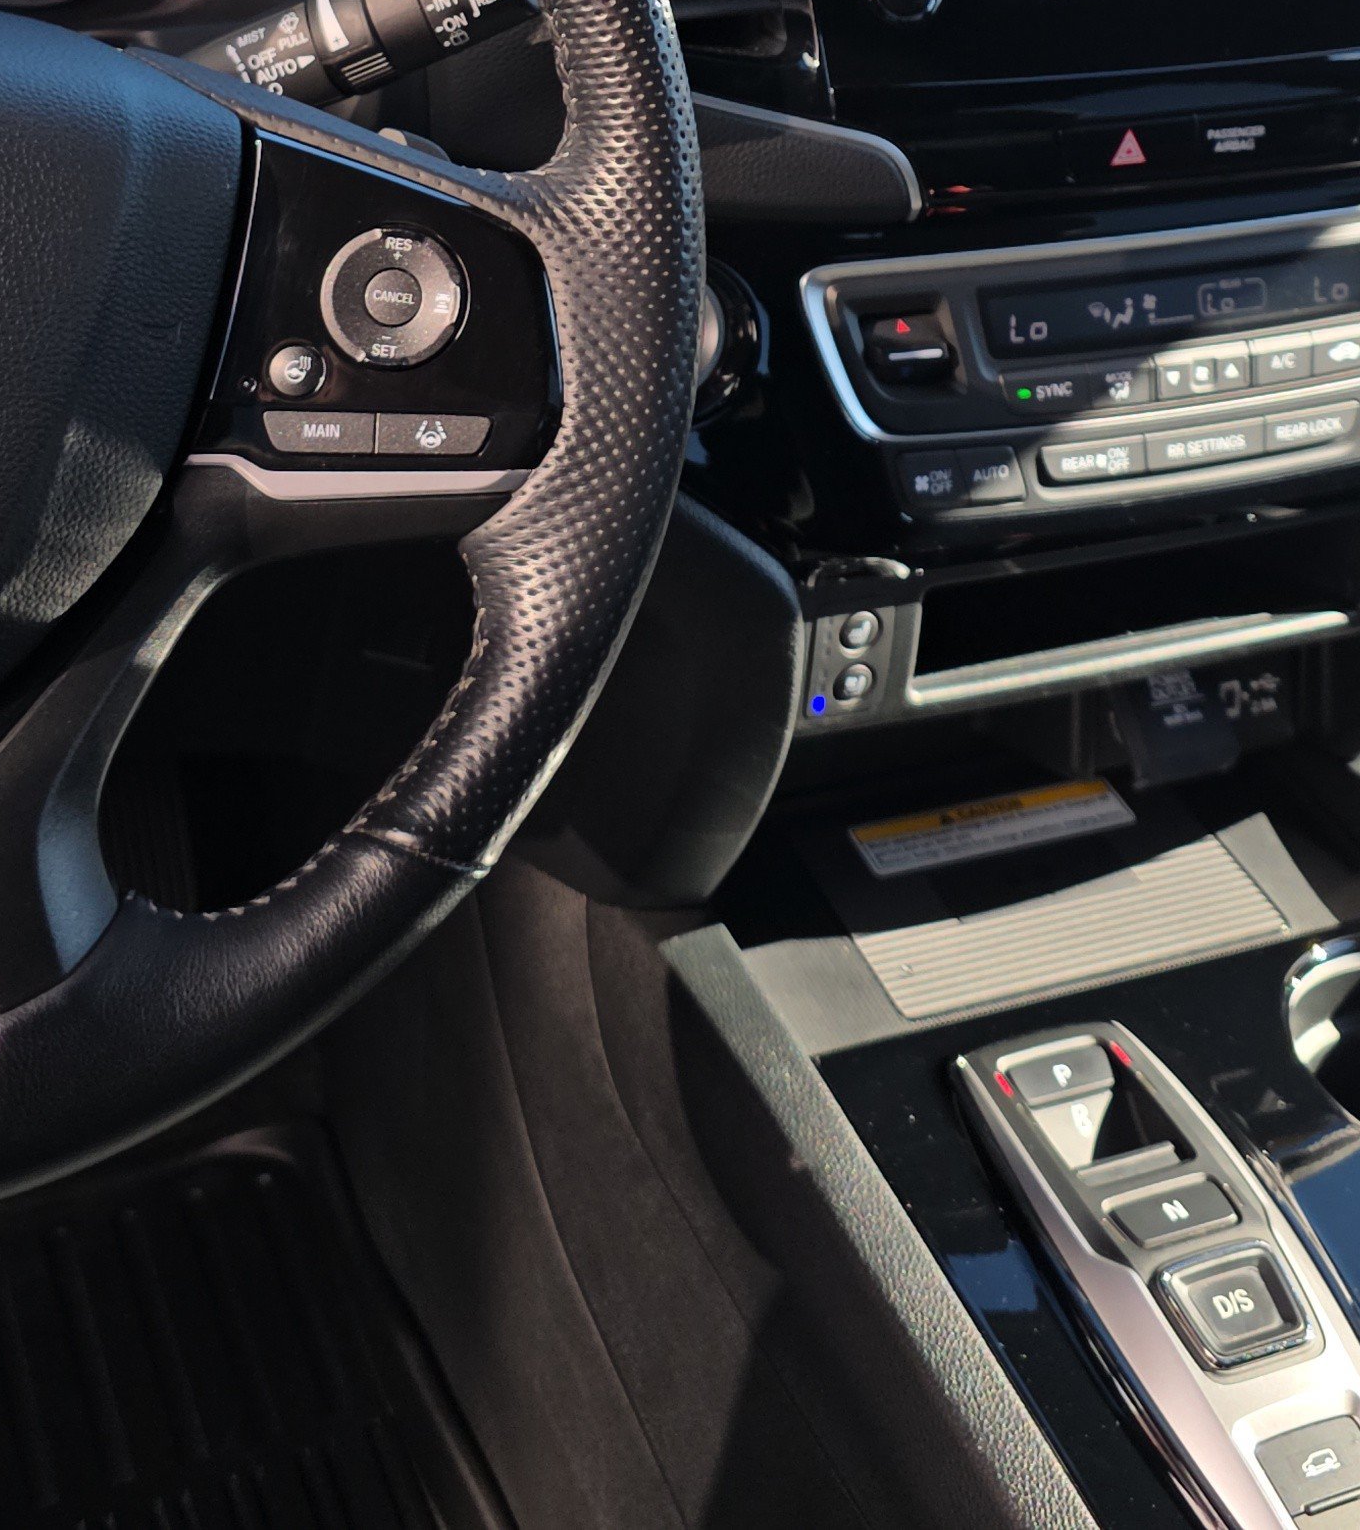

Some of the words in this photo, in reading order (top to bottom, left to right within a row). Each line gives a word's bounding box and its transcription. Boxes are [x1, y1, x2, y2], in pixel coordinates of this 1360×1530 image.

[442, 12, 468, 32] ON
[237, 27, 266, 48] MIST
[277, 32, 309, 51] PULL
[248, 47, 277, 70] OFF
[256, 58, 297, 85] AUTO
[385, 236, 413, 251] RES
[373, 290, 415, 305] CANCEL
[1010, 314, 1049, 343] Lo
[371, 344, 398, 359] SET
[1271, 352, 1297, 370] A/C
[1036, 381, 1074, 403] SYNC
[303, 423, 341, 440] MAIN
[1276, 421, 1309, 440] REAR
[1309, 417, 1343, 435] LOCK
[1166, 442, 1187, 459] RR
[1187, 434, 1246, 455] SETTINGS
[973, 464, 1010, 482] AUTO
[1061, 454, 1095, 472] REAR
[1107, 457, 1131, 473] OFF
[930, 479, 953, 495] OFF
[1052, 1063, 1073, 1087] P
[1070, 1103, 1093, 1137] R
[1161, 1199, 1190, 1222] N
[1210, 1284, 1257, 1321] D/S
